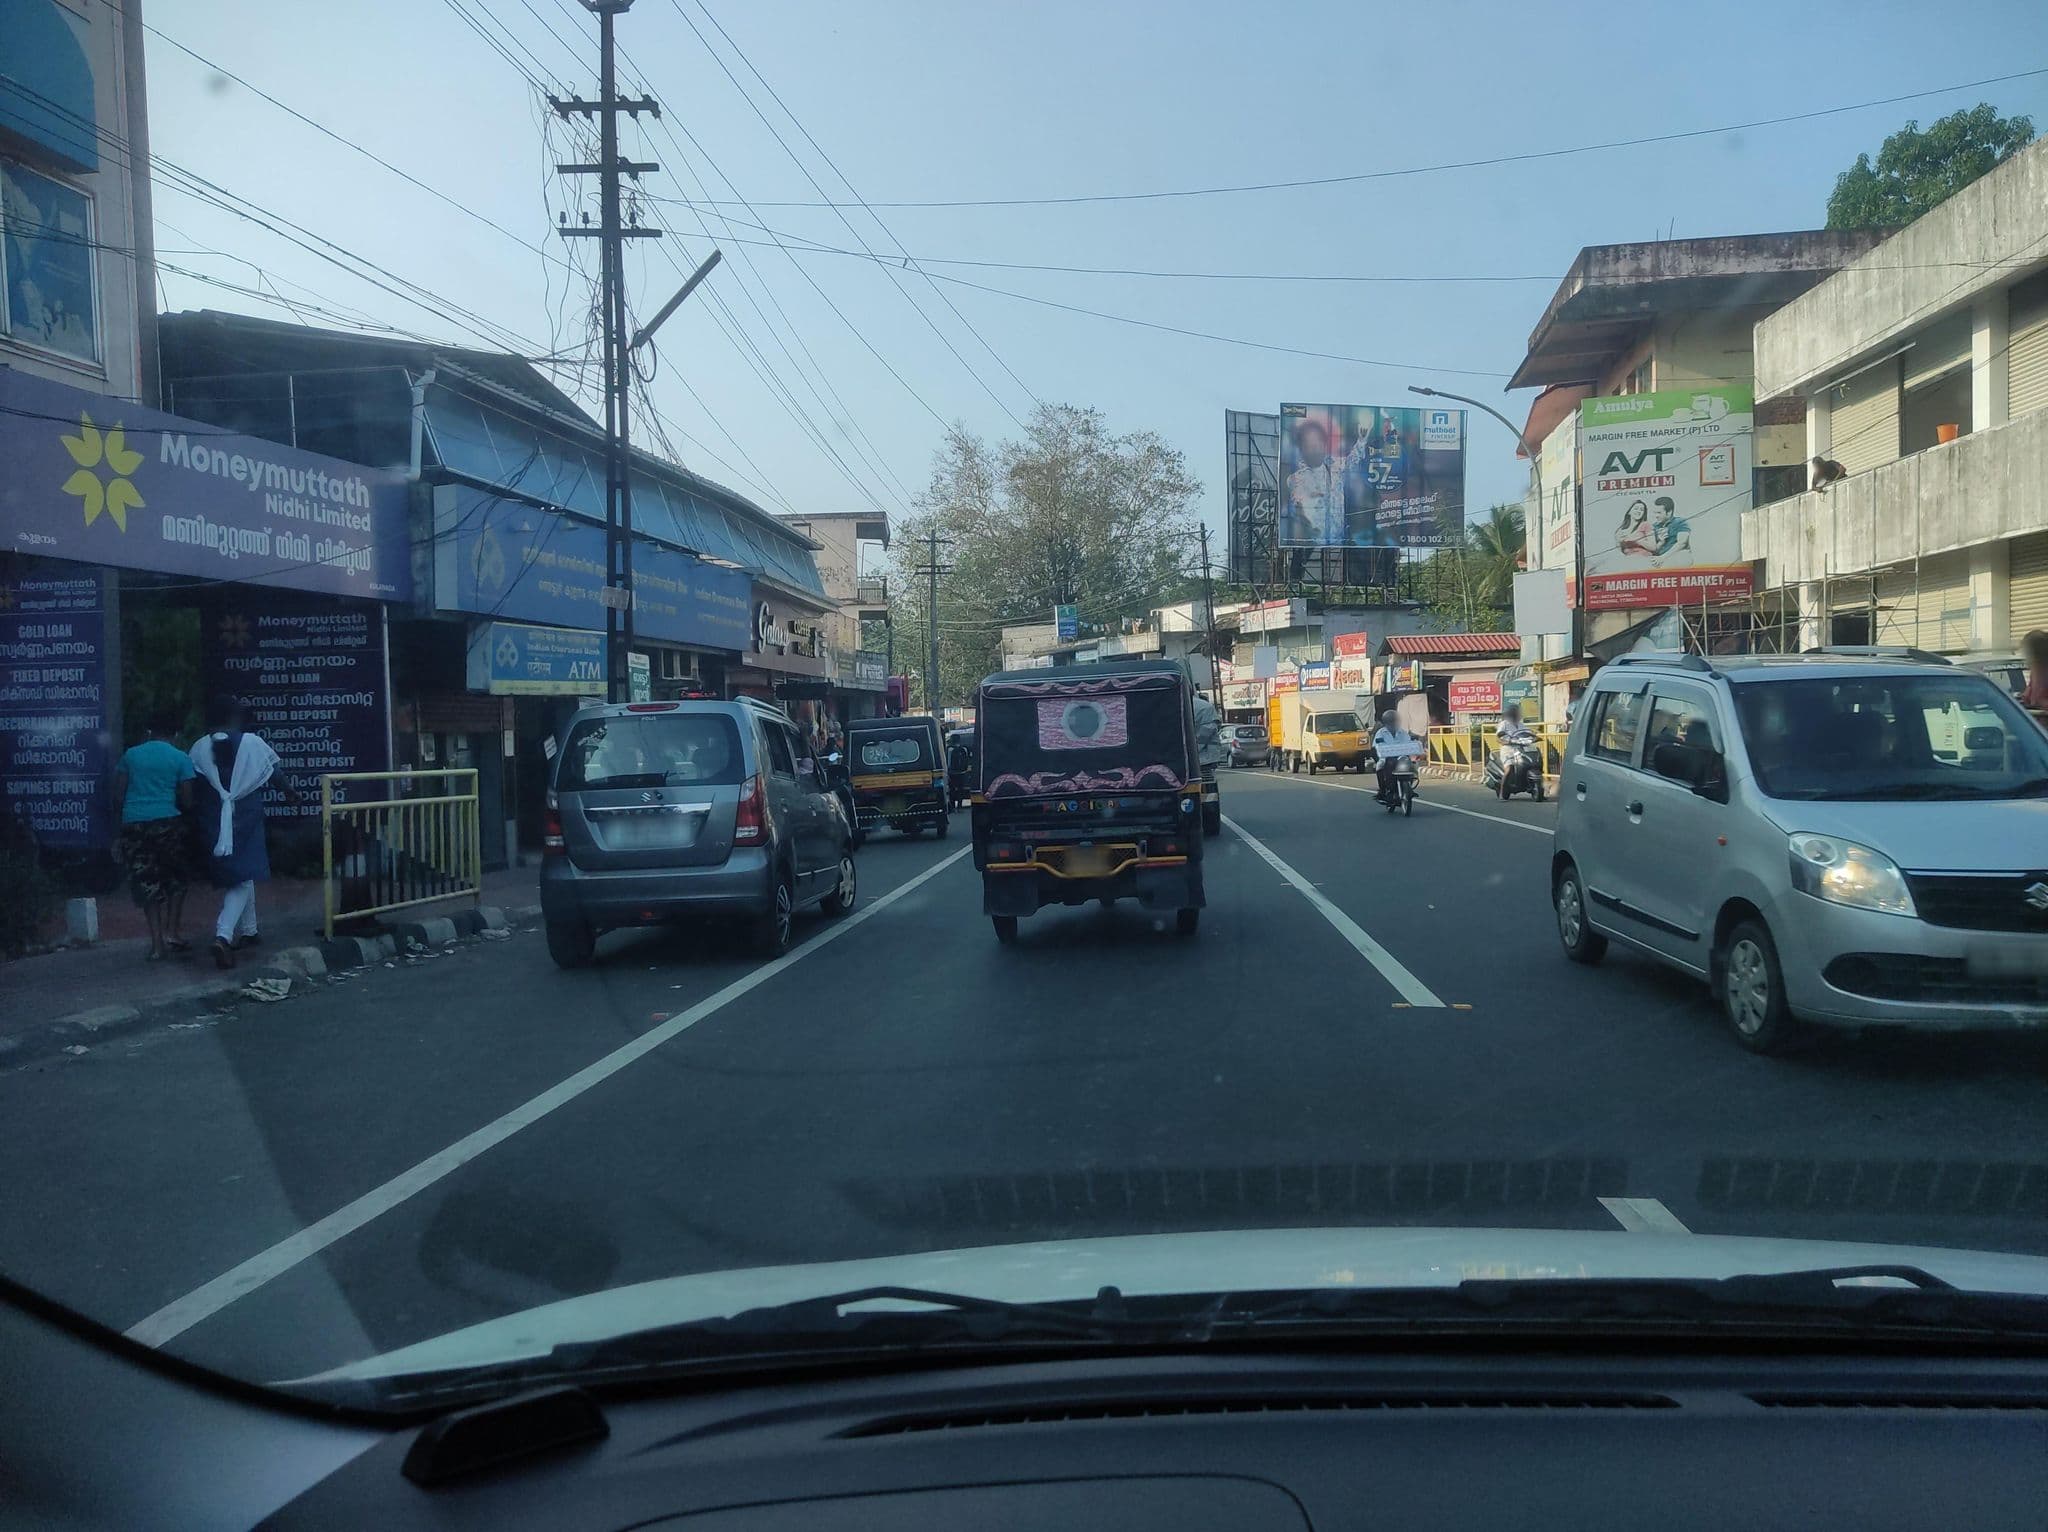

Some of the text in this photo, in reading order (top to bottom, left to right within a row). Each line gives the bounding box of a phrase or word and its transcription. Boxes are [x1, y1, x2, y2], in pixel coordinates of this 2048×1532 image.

[1593, 398, 1654, 414] Amulya
[1588, 424, 1720, 442] MARGIN FREE MARKET (P) LTD
[1599, 447, 1674, 476] AVT
[160, 431, 370, 507] Moneymuttath
[1367, 462, 1393, 484] 57
[1599, 476, 1674, 490] PREMIUM
[266, 493, 371, 532] Nidhi Limited
[1407, 535, 1427, 543] 1800
[1429, 535, 1442, 543] 102
[20, 578, 96, 591] Moneymuttath
[1606, 578, 1647, 592] MARGIN
[1651, 577, 1677, 589] FREE
[1681, 575, 1724, 587] MARKET
[257, 613, 366, 627] Moneymuttath
[18, 624, 72, 638] GOLD LOAN
[758, 600, 790, 655] Galaxy
[13, 668, 86, 683] FIXED DEPOSIT
[568, 661, 601, 680] ATM
[259, 672, 320, 684] GOLD LOAN
[1334, 668, 1365, 689] REGAL
[60, 715, 99, 729] DEPOSIT
[257, 709, 338, 721] FIXED DEPOSIT
[307, 757, 356, 767] DEPOSIT
[7, 780, 95, 794] SAVINGS DEPOSIT
[264, 806, 298, 817] VINGS
